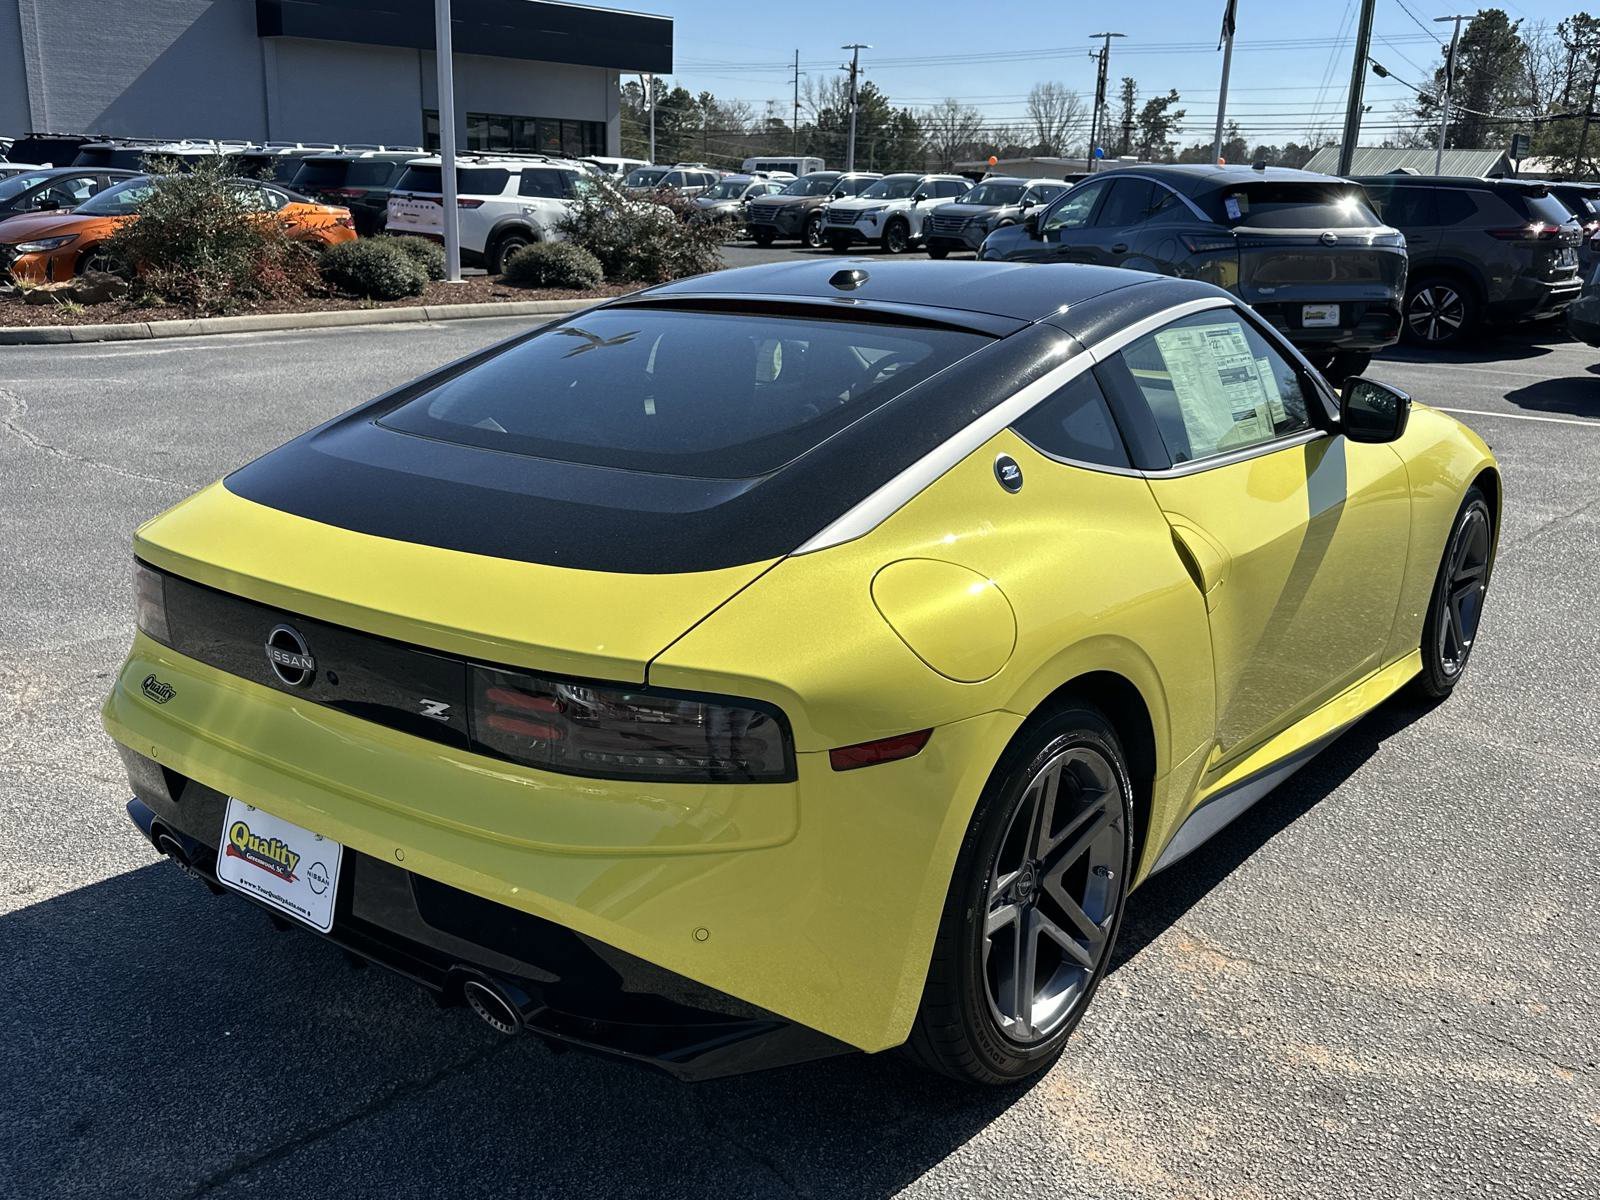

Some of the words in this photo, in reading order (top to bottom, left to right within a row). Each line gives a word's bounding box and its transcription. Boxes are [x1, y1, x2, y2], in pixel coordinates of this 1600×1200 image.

[143, 675, 175, 700] Quality
[230, 822, 300, 872] Quality
[306, 870, 330, 887] NISSAN
